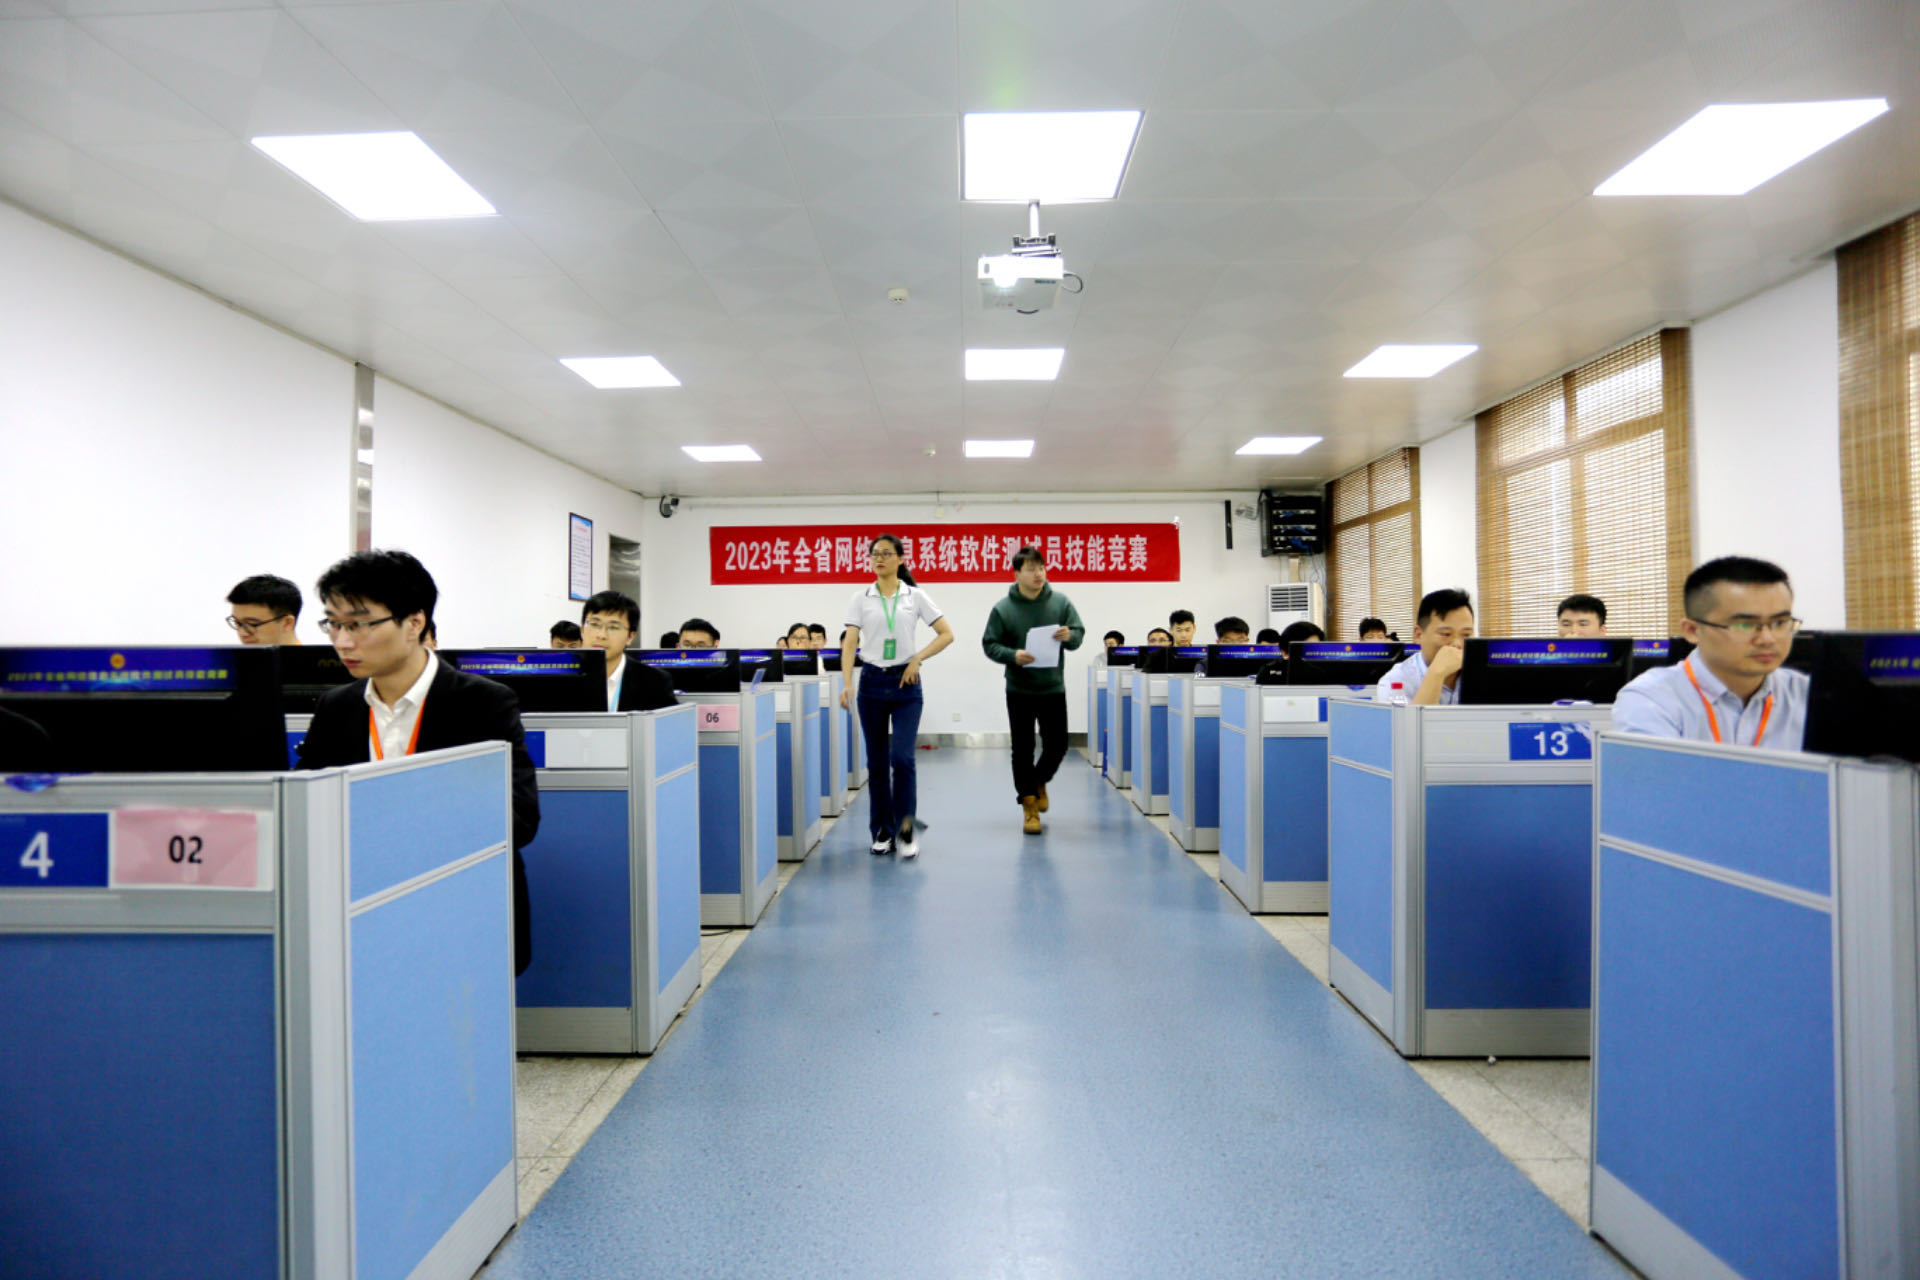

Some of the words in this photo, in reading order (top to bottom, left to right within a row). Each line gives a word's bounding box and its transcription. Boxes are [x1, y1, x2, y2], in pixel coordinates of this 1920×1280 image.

[705, 712, 720, 723] 06
[1533, 731, 1569, 756] 13
[19, 831, 54, 878] 4
[168, 835, 203, 864] 02
